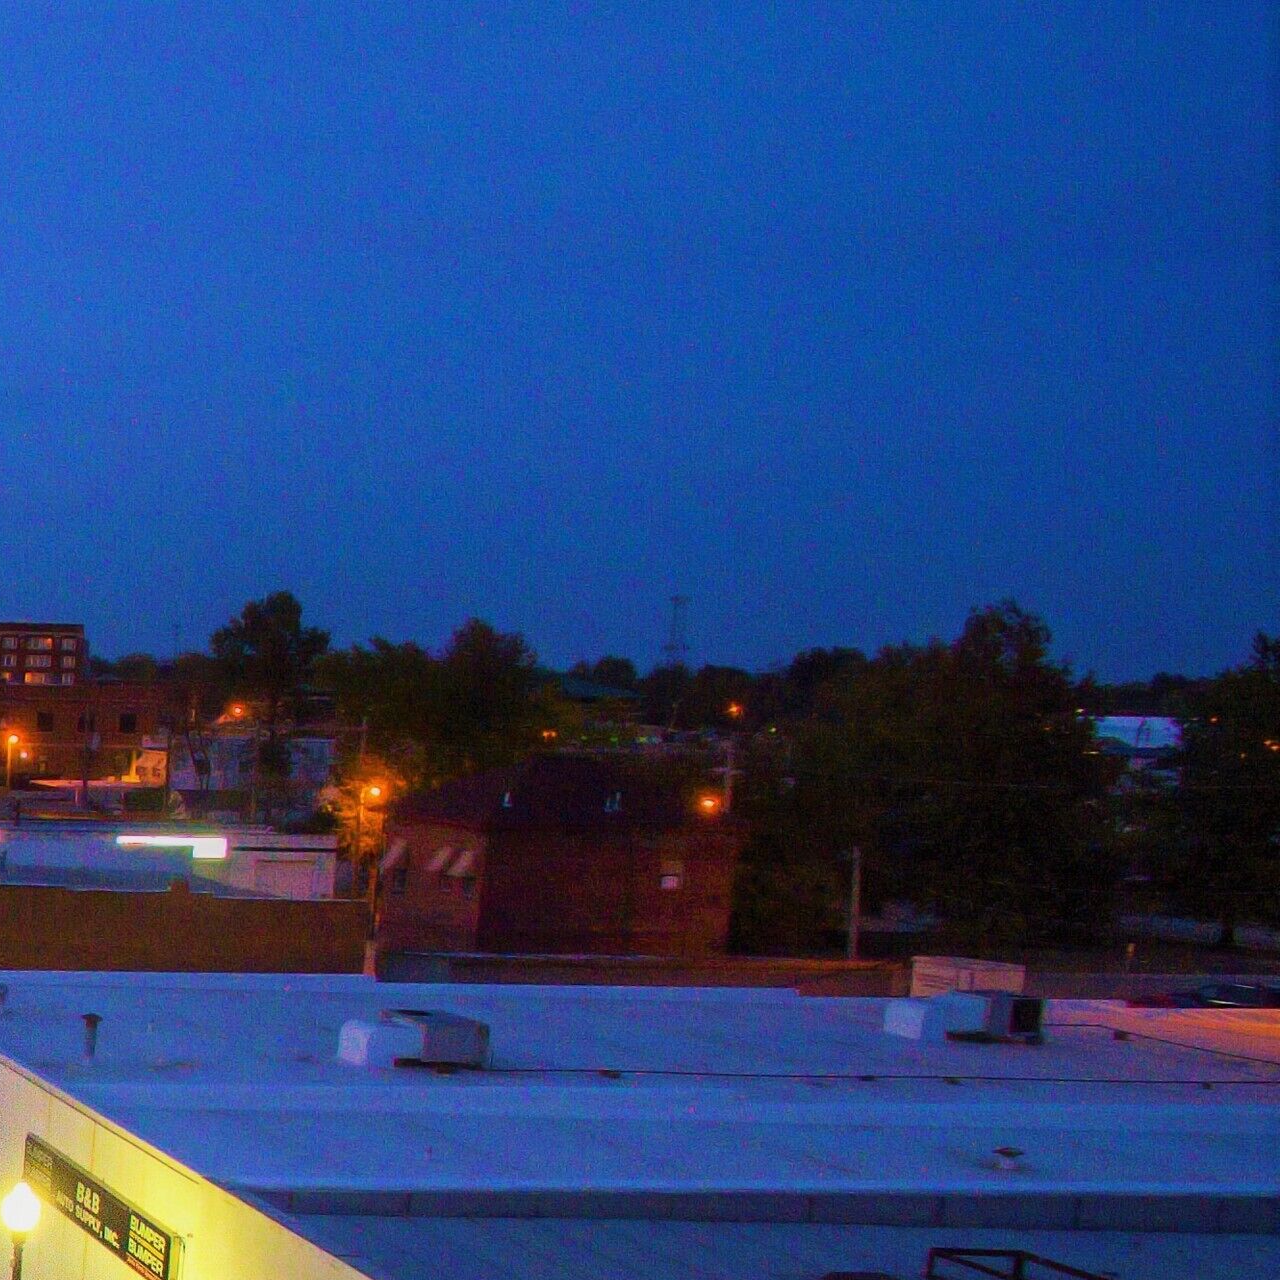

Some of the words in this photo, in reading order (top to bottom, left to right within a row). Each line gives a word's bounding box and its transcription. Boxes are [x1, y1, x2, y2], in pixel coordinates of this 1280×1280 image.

[76, 1181, 100, 1215] B&B
[129, 1214, 166, 1255] BUMPER
[127, 1237, 163, 1278] BUMPER
